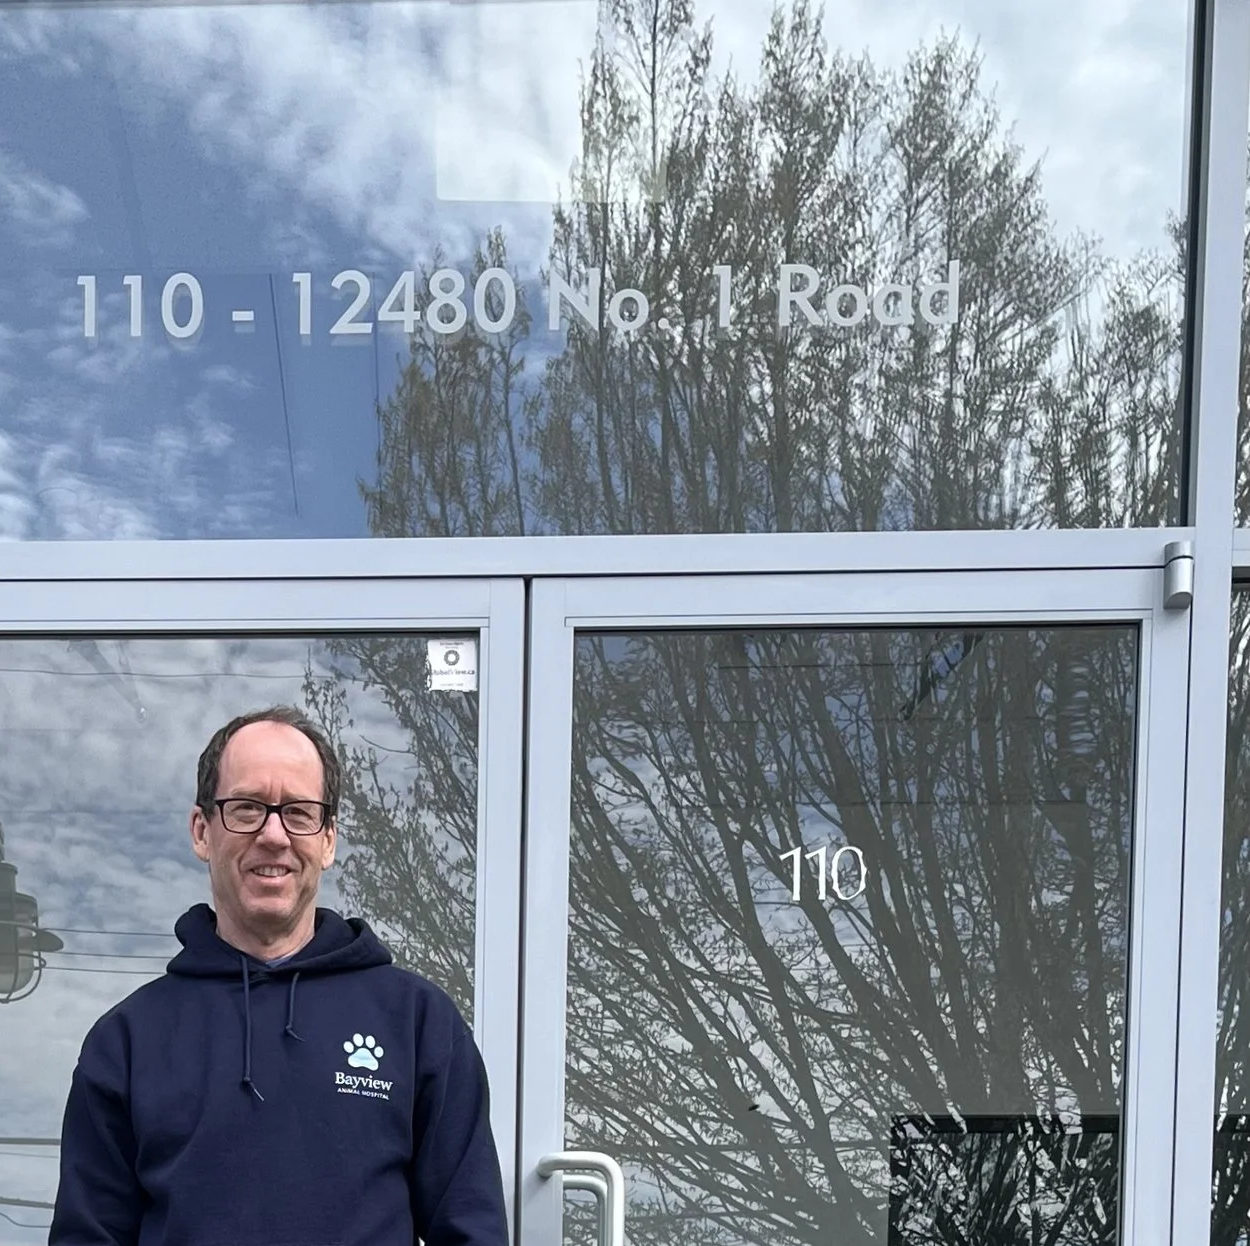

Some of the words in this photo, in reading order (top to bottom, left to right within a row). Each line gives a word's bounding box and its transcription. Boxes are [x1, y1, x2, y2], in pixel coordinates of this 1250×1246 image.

[76, 271, 204, 339] 110
[291, 267, 518, 336] 12480
[548, 267, 671, 332] No.
[713, 264, 732, 328] 1
[778, 259, 960, 327] Road
[778, 845, 868, 901] 110
[335, 1071, 394, 1092] Bayview
[336, 1087, 361, 1095] ANIMAL
[361, 1090, 390, 1101] HOSPITAL
